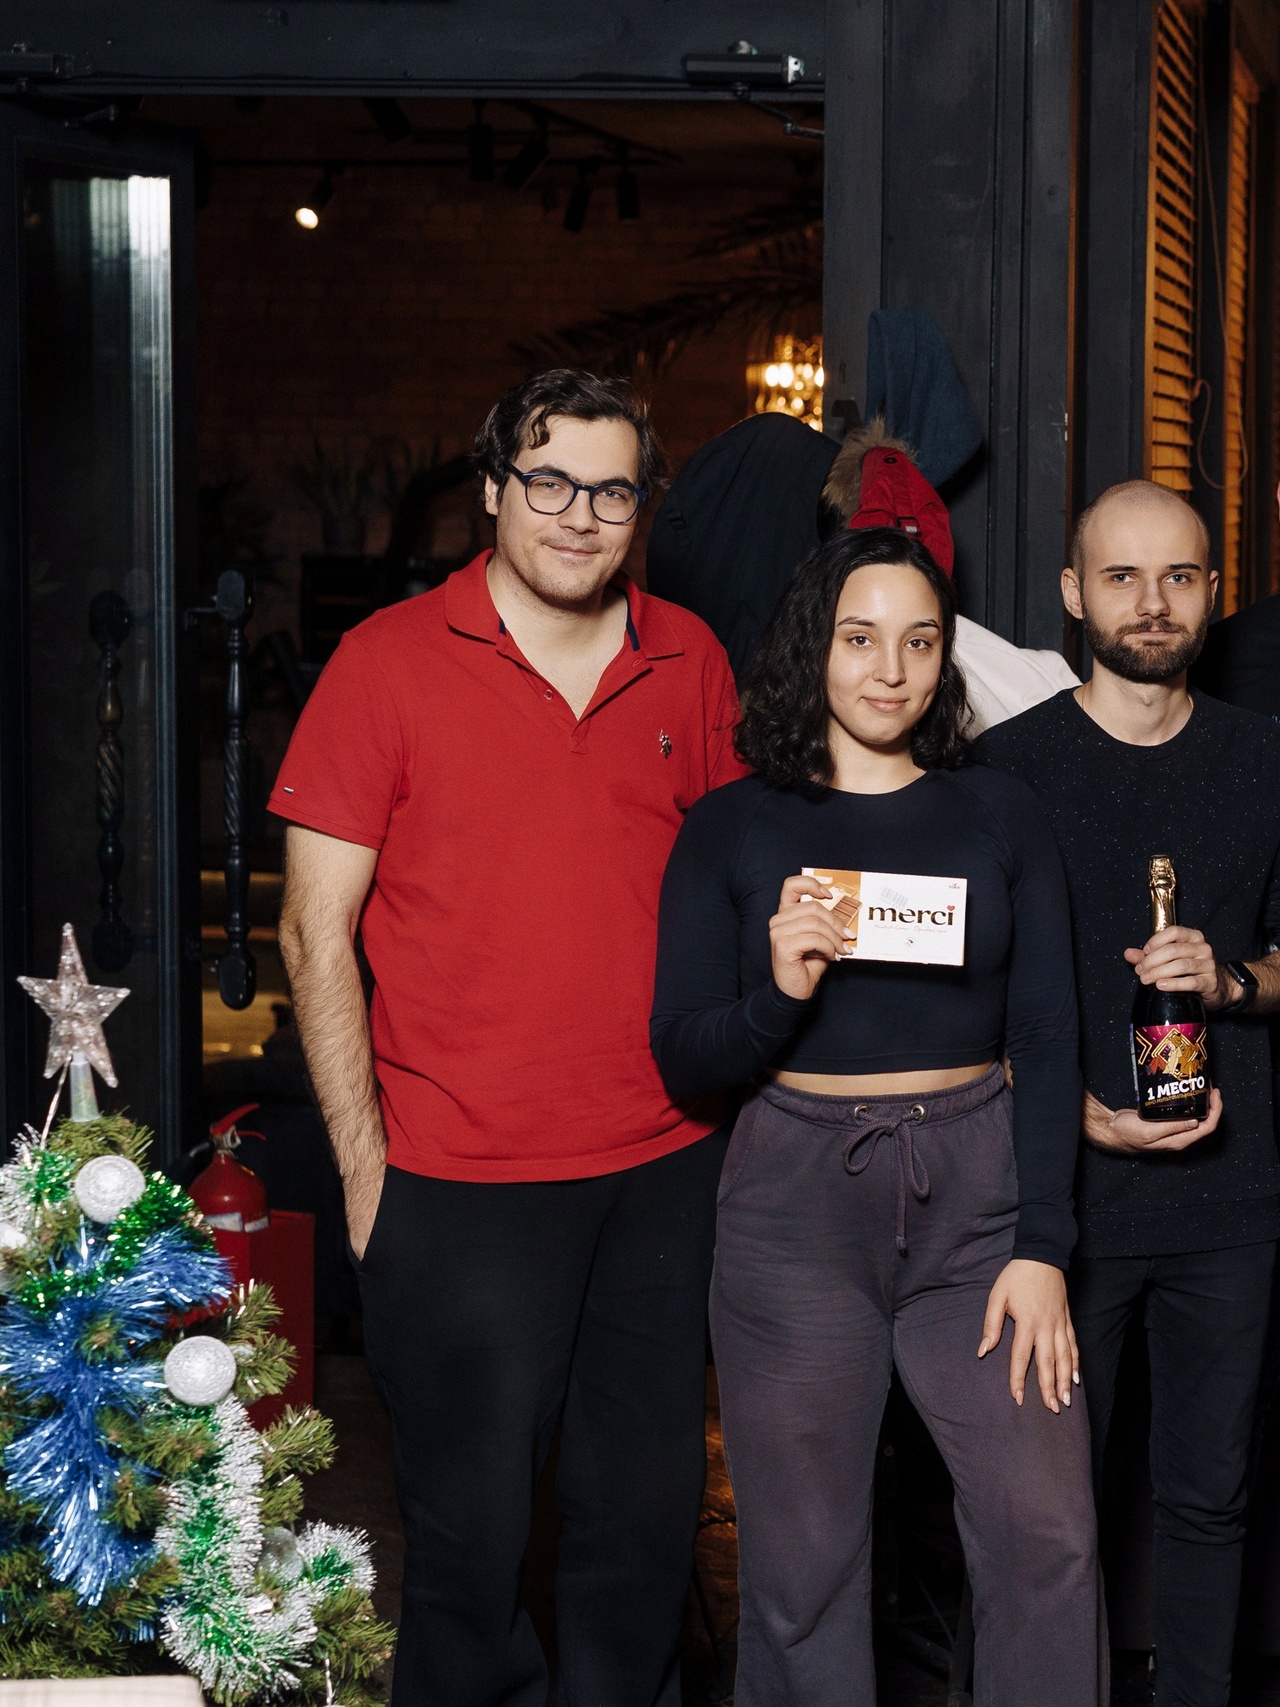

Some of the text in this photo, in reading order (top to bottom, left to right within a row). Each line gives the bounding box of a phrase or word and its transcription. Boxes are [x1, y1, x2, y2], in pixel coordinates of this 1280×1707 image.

[868, 905, 955, 926] merci
[1147, 1087, 1156, 1100] 1
[1157, 1076, 1205, 1098] МЕСТО
